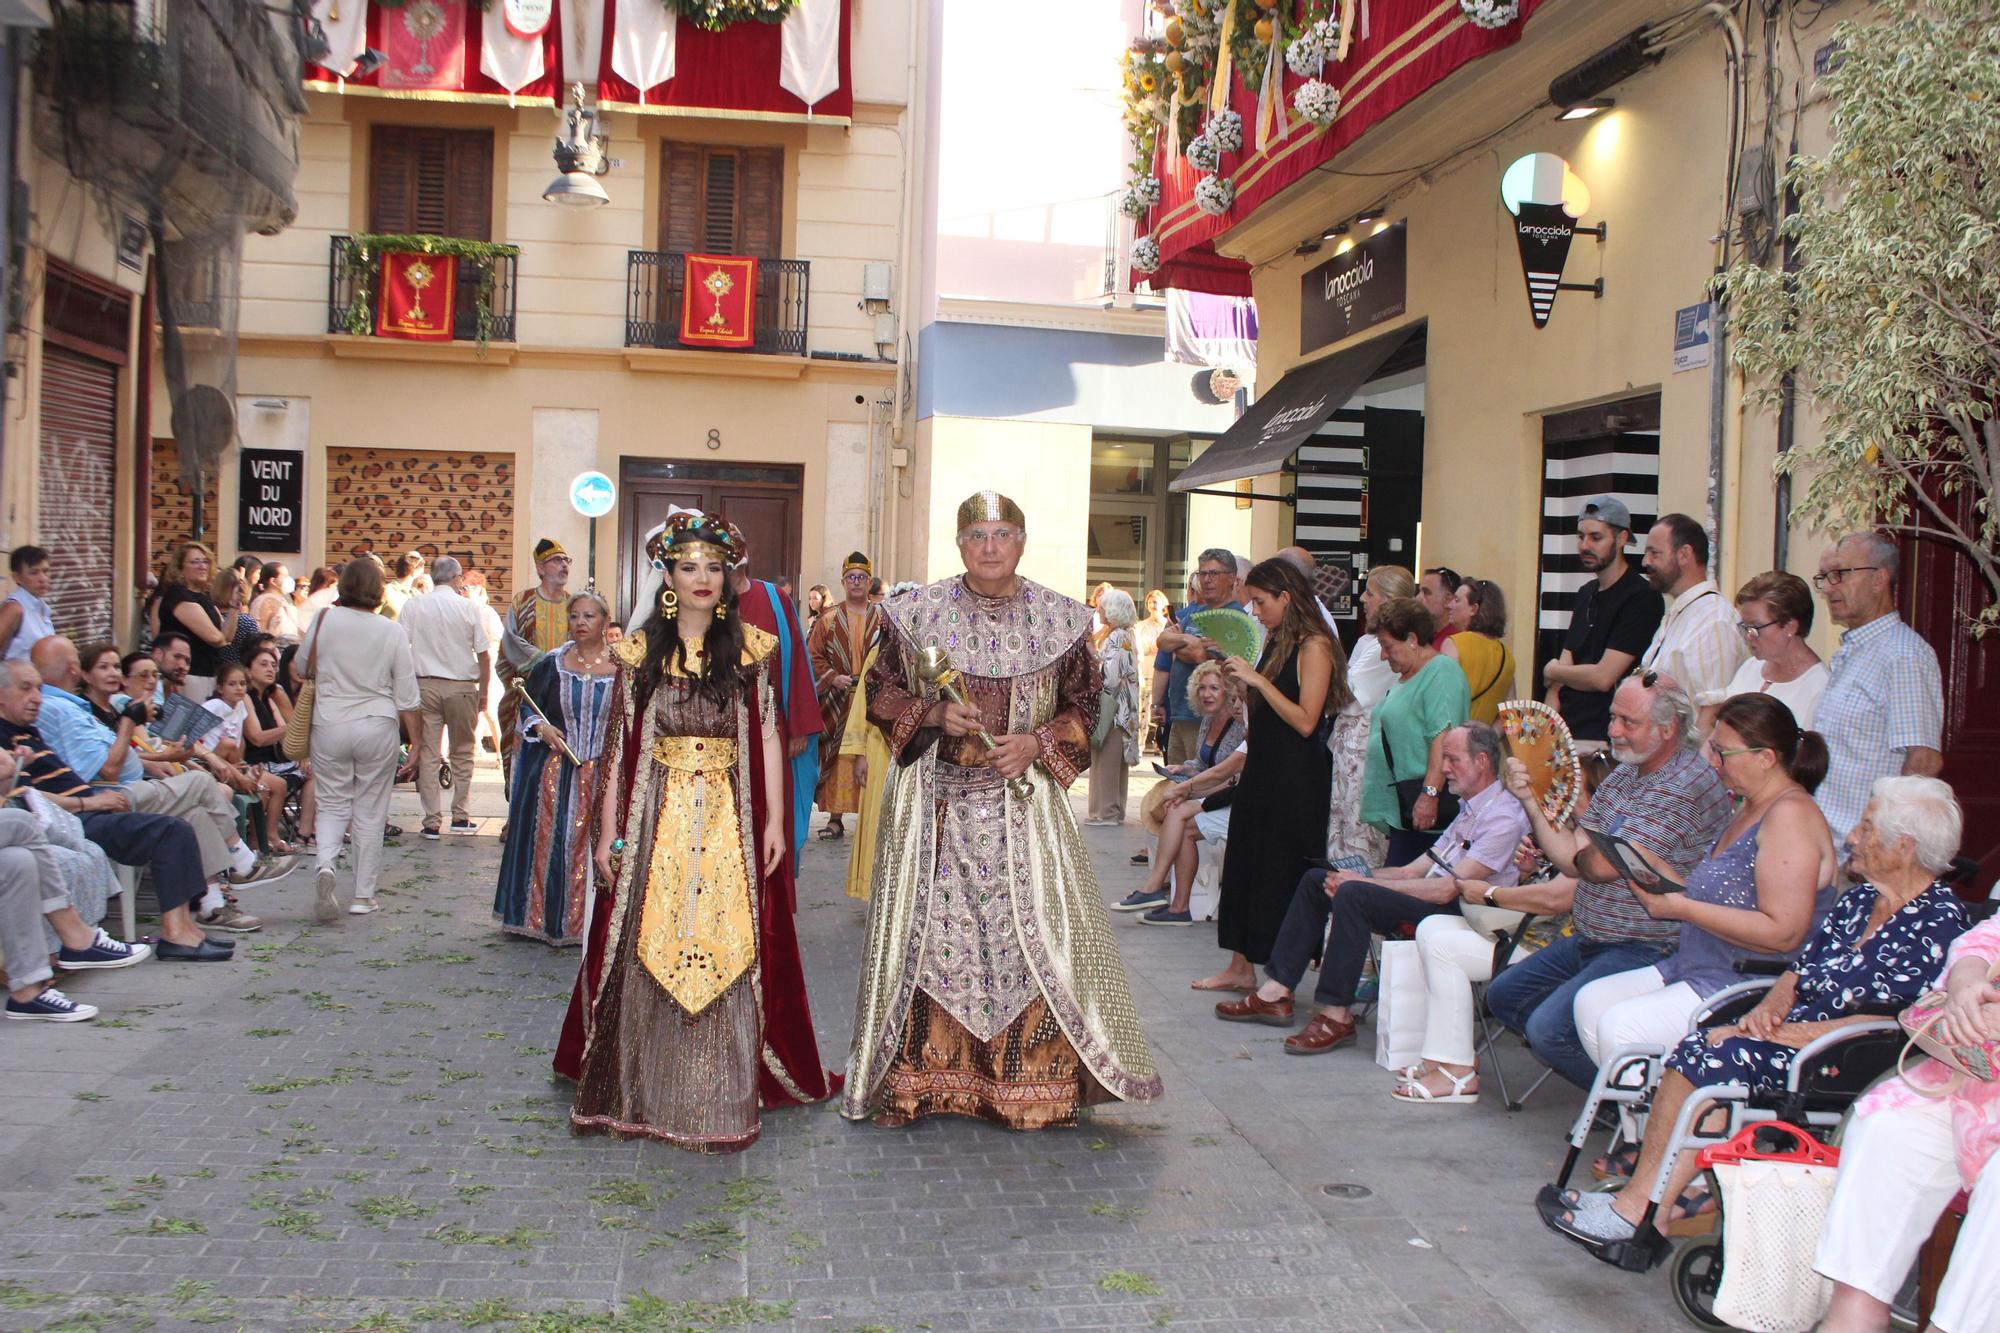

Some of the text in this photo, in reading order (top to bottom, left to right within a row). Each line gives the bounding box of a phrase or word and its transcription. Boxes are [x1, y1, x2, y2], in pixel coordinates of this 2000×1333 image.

[1519, 221, 1571, 236] lanocciola
[1325, 250, 1373, 302] lanocciola
[1336, 288, 1361, 307] TOSCANA
[707, 429, 721, 450] 8
[251, 460, 293, 480] VENT
[261, 485, 280, 501] DU
[248, 506, 292, 526] NORD
